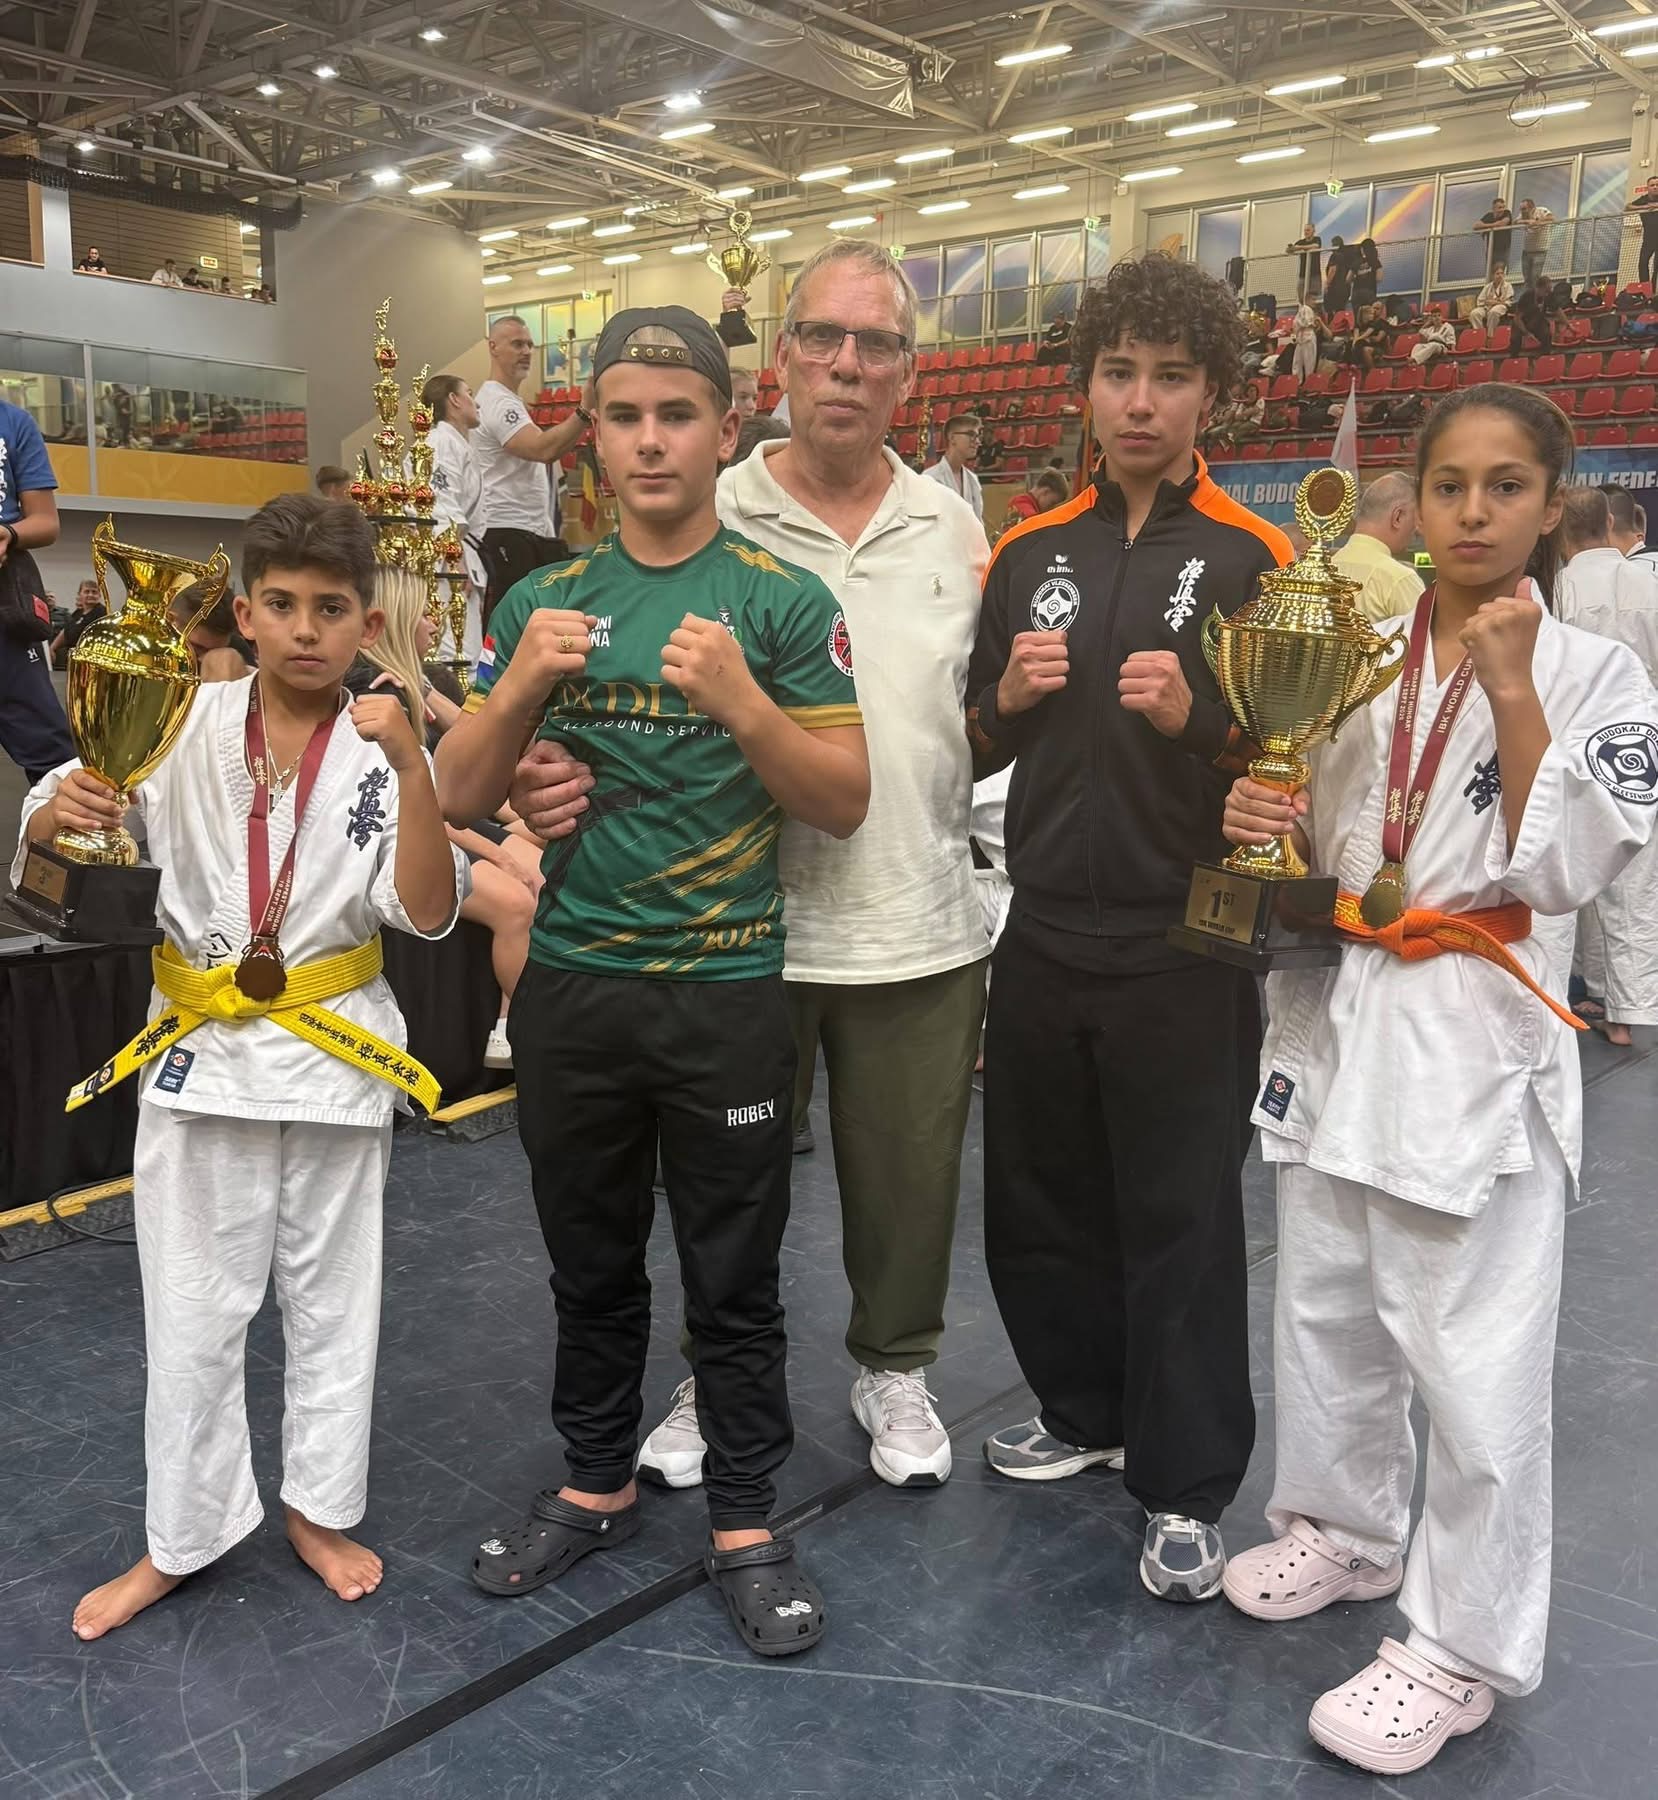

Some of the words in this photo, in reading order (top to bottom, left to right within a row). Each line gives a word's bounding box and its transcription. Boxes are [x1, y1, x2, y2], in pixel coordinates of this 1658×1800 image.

[1608, 471, 1658, 489] FEDE
[1436, 715, 1451, 734] IBK
[1444, 679, 1465, 714] WORLD
[563, 719, 654, 735] ALLROUND
[1596, 725, 1640, 743] BUDOKAI
[727, 1099, 774, 1126] ROBEY
